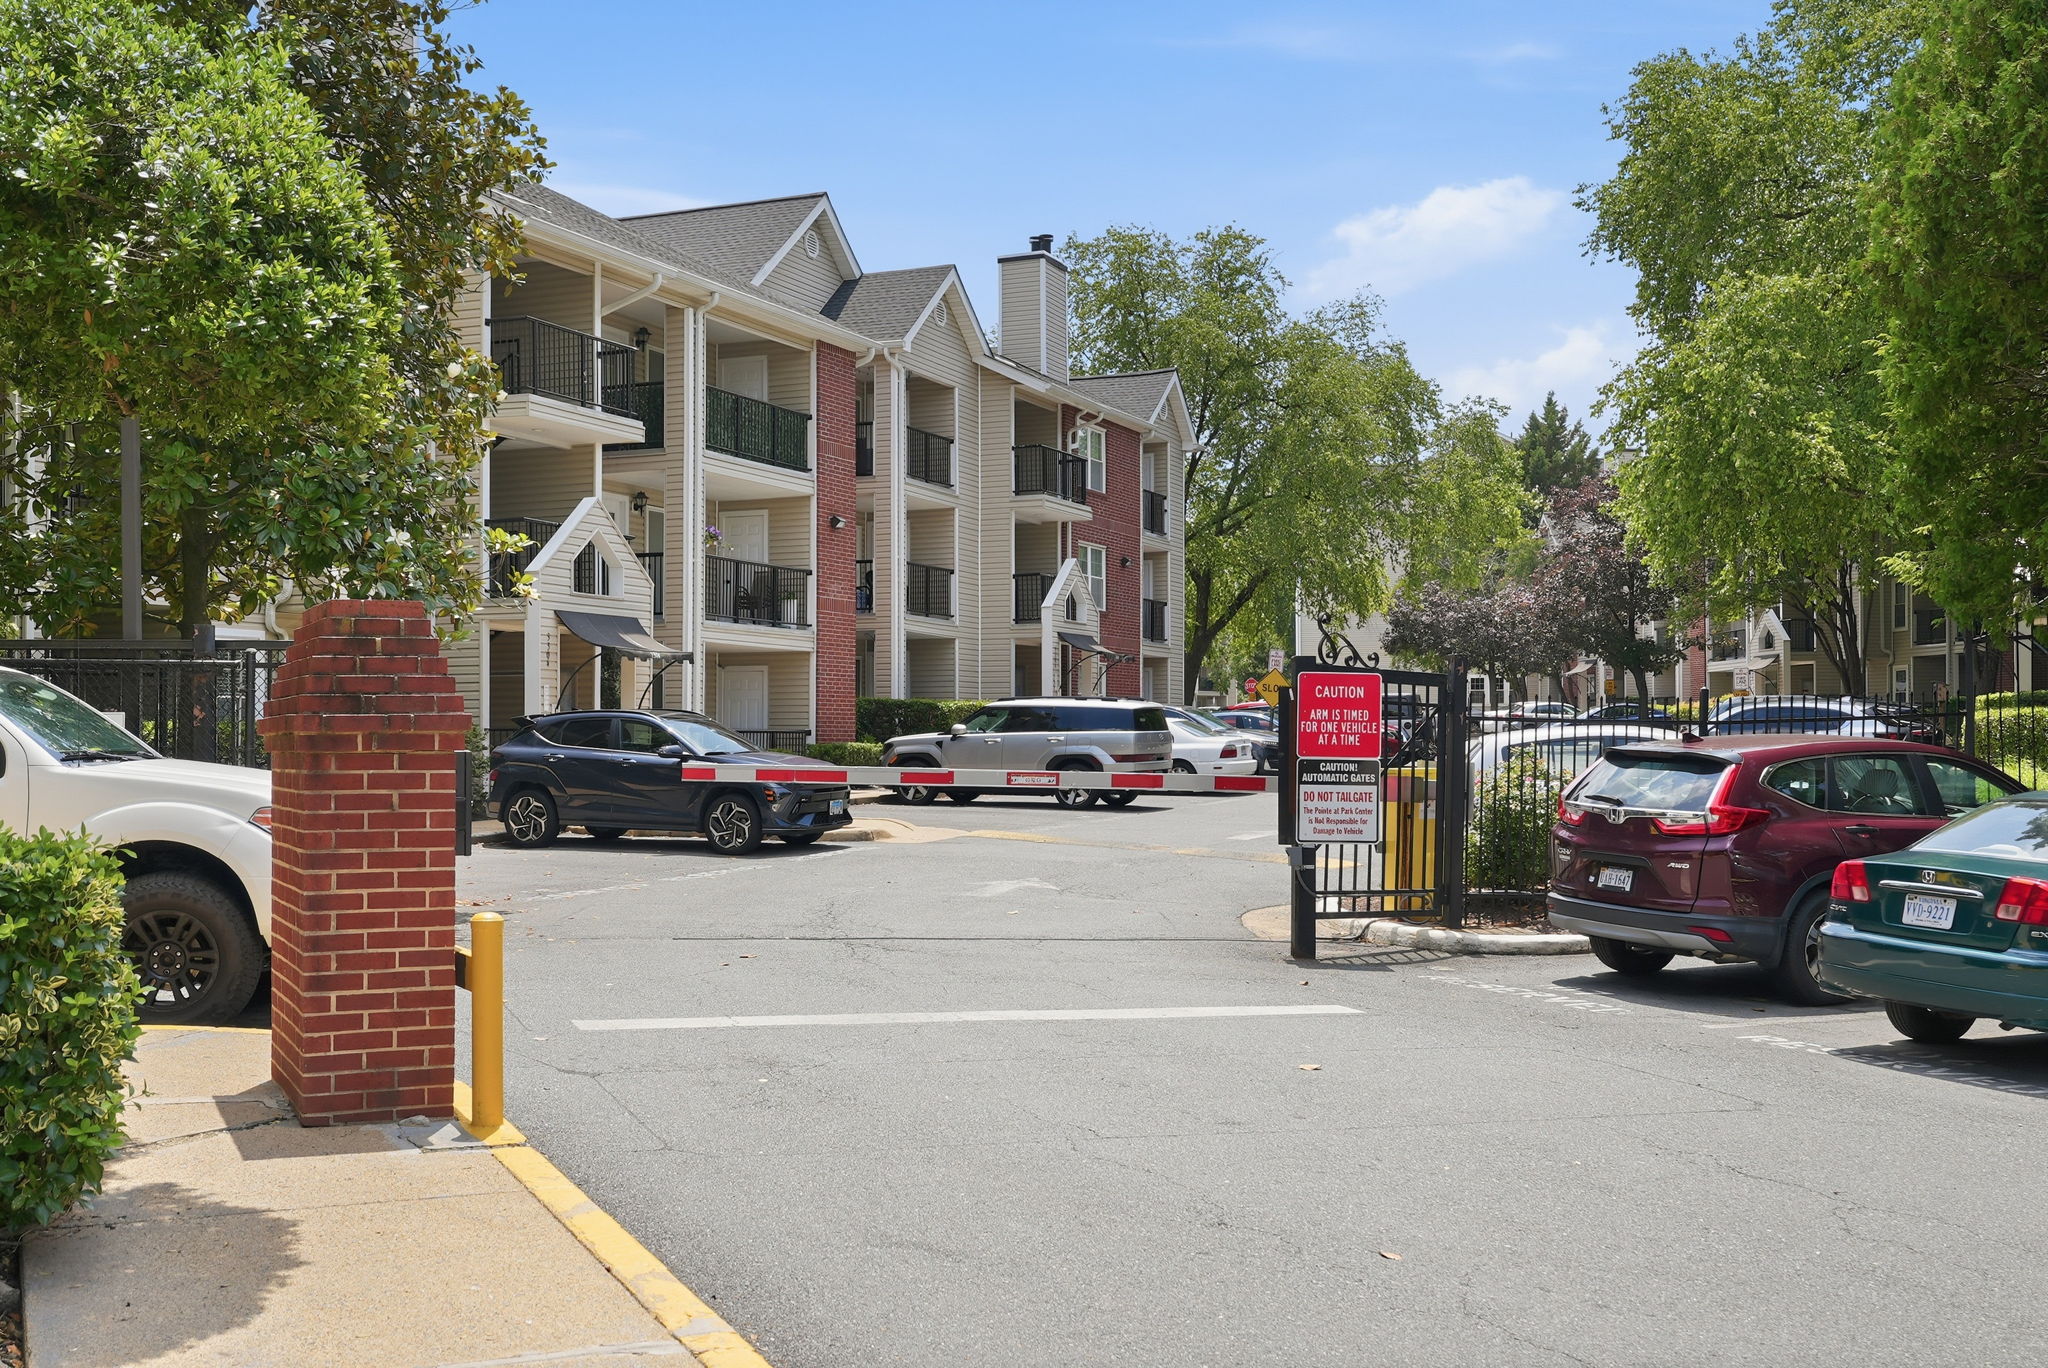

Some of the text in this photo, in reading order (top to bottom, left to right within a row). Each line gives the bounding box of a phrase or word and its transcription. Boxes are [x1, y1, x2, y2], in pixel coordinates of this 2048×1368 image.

[1262, 684, 1279, 692] SLO
[1315, 685, 1364, 698] CAUTION
[1310, 709, 1369, 721] ARM IS TIMED
[1301, 721, 1377, 733] FOR ONE VEHICLE
[1318, 734, 1360, 745] AT A TIME
[1320, 762, 1358, 771] CAUTION!
[1302, 773, 1376, 782] AUTOMATIC GATES
[1303, 791, 1373, 802] DO NOT TAILGATE
[1326, 817, 1359, 825] Responsible
[1313, 827, 1335, 835] Damage
[1344, 827, 1363, 835] Vehicle
[1906, 901, 1950, 920] VVD-9221
